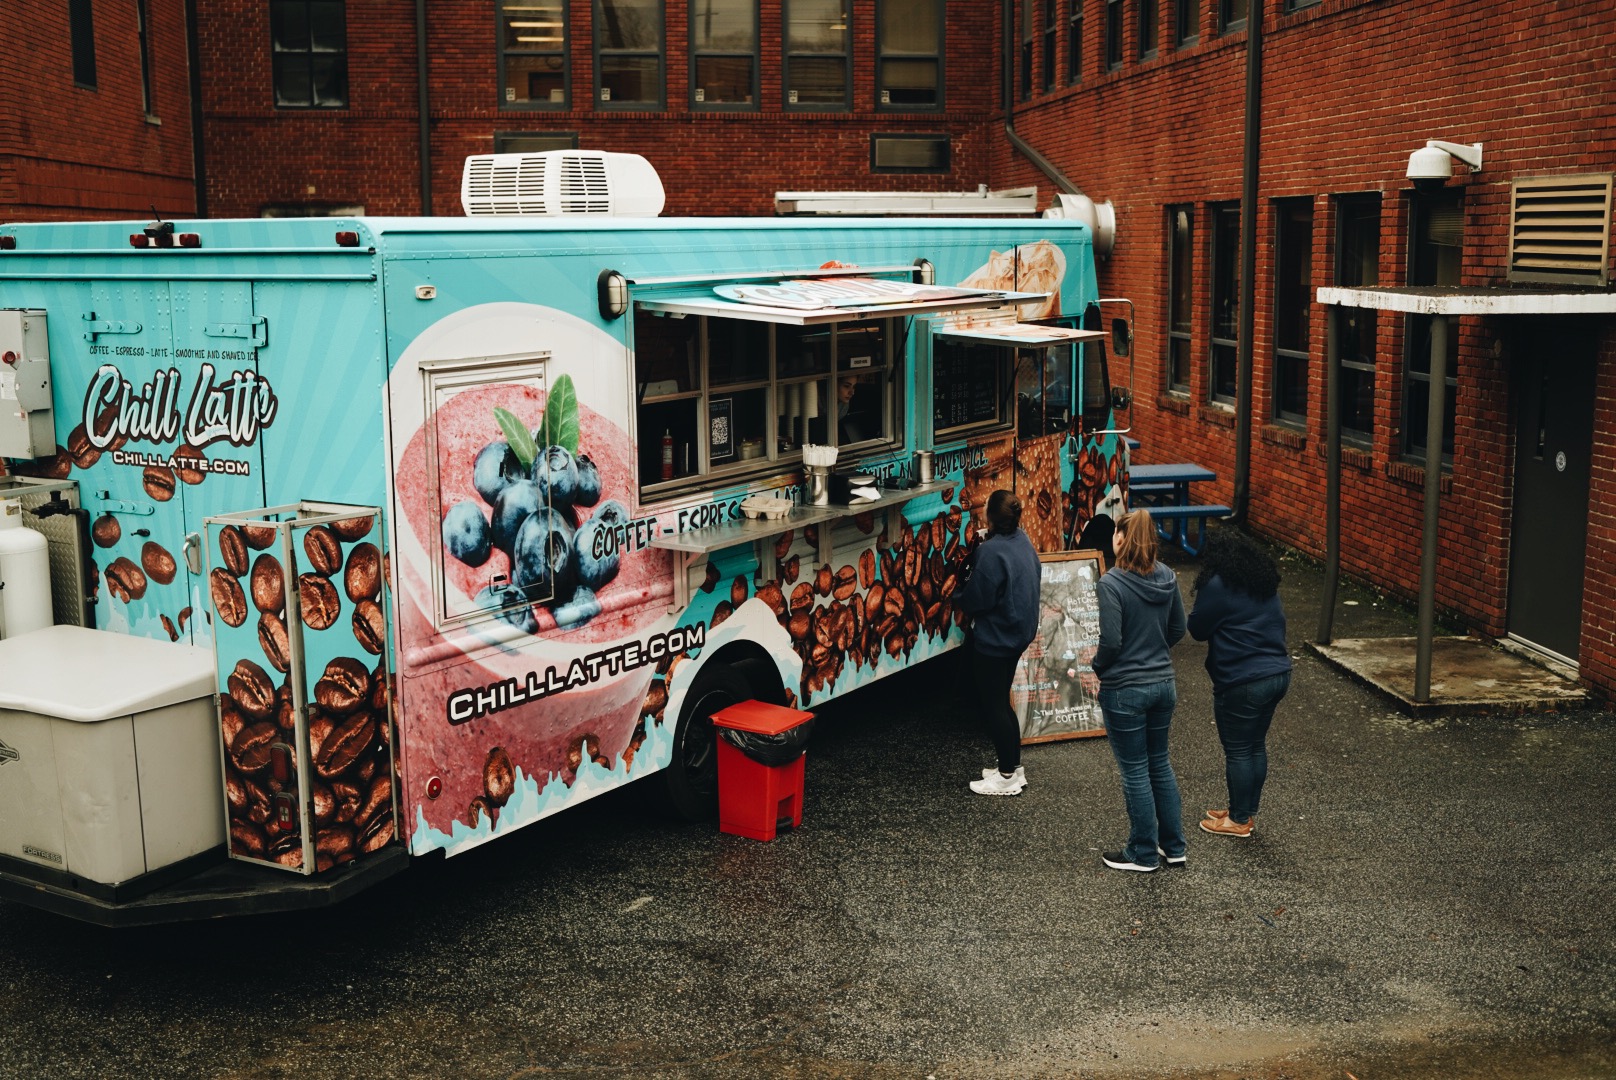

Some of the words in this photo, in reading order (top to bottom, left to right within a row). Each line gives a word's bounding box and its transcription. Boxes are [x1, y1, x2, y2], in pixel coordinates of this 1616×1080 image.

[89, 345, 110, 355] COFFEE
[115, 346, 145, 357] ESPRESSO
[150, 347, 168, 358] LATTE
[175, 348, 205, 360] SMOOTHIE
[207, 349, 220, 360] AND
[221, 350, 246, 362] SHAVED
[84, 363, 182, 448] Chill
[184, 363, 277, 448] Latte
[114, 451, 249, 475] CHILLLATTE.COM
[591, 517, 658, 561] COFFEE
[678, 494, 756, 534] ESPRES
[935, 449, 967, 478] HAVED
[1067, 597, 1081, 607] Hot
[1082, 596, 1098, 604] Choc
[1081, 590, 1096, 598] Tea
[448, 624, 706, 724] CHILLLATTE.COM
[1039, 681, 1051, 690] Ice
[1040, 709, 1054, 717] This
[1055, 711, 1089, 723] COFFEE
[23, 847, 61, 862] FORTRESS
